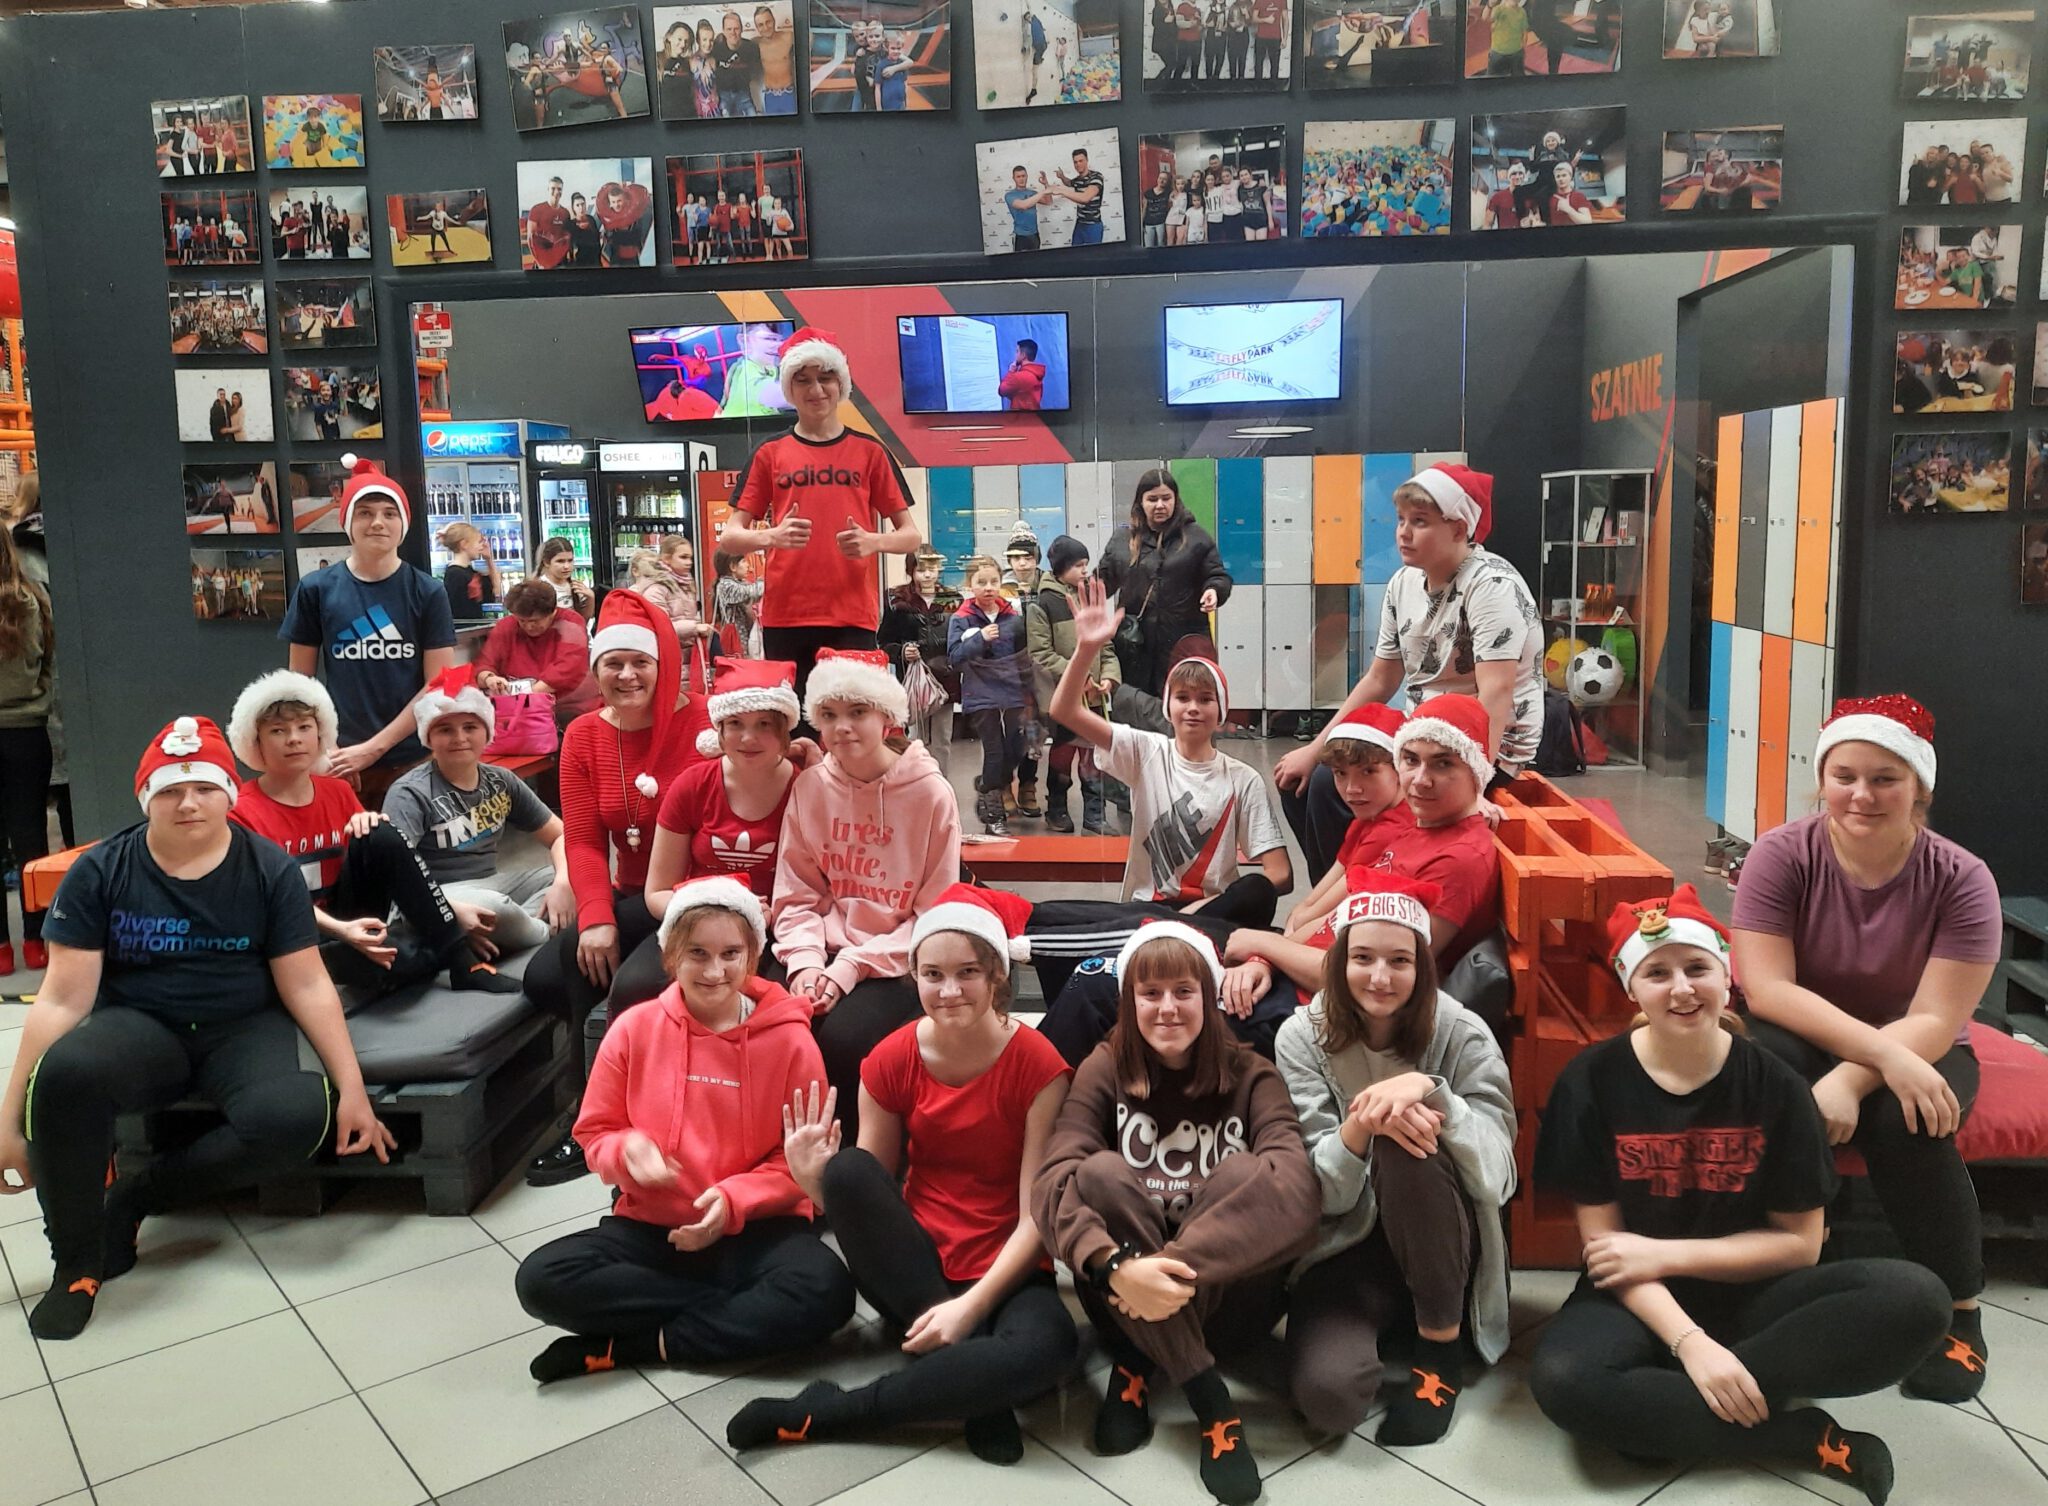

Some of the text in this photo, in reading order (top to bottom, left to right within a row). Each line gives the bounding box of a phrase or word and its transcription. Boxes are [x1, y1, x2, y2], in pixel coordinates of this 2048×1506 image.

[1591, 353, 1663, 423] SZATNIE
[449, 432, 493, 449] pepsi
[603, 452, 640, 462] OSHEE
[777, 463, 861, 490] adidas
[331, 638, 415, 660] adidas
[285, 829, 341, 854] TOMM
[428, 880, 454, 923] BREAK
[1372, 896, 1395, 916] BIG
[111, 909, 191, 935] Diverse
[1168, 1179, 1190, 1192] the
